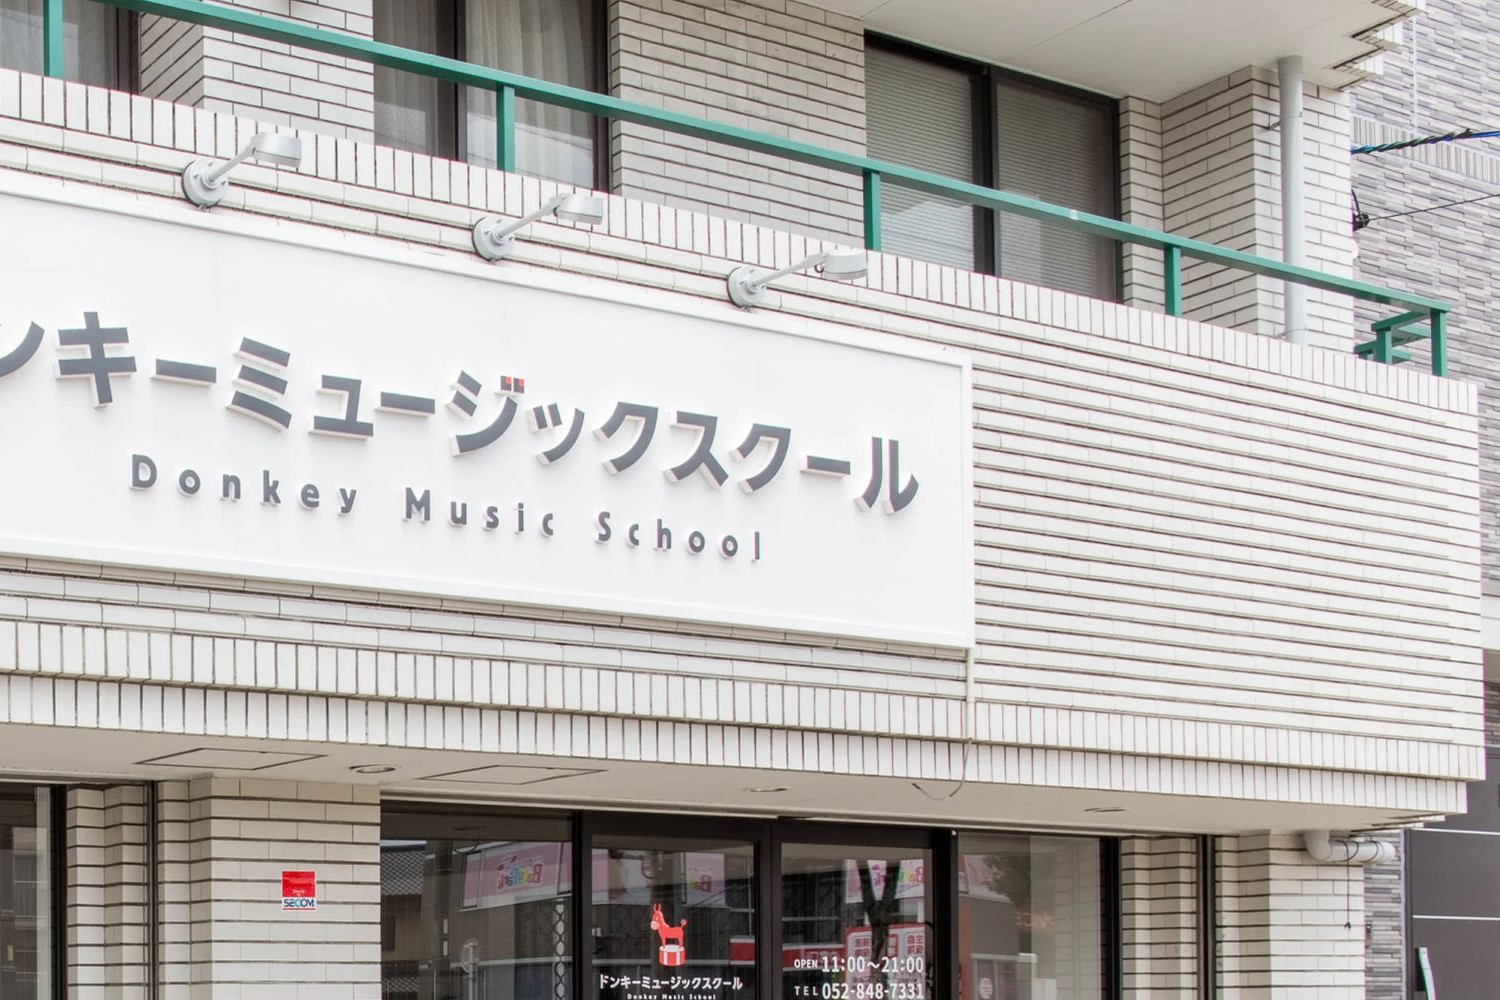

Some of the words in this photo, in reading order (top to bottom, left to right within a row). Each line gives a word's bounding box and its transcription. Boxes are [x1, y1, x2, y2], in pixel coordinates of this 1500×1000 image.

[130, 453, 357, 514] Donkey
[404, 487, 554, 536] Music
[598, 511, 761, 562] School
[284, 898, 315, 908] SECOM
[794, 959, 818, 968] OPEN
[599, 974, 743, 990] ドンキーミュージックスクール
[822, 983, 924, 999] 052-848-7331
